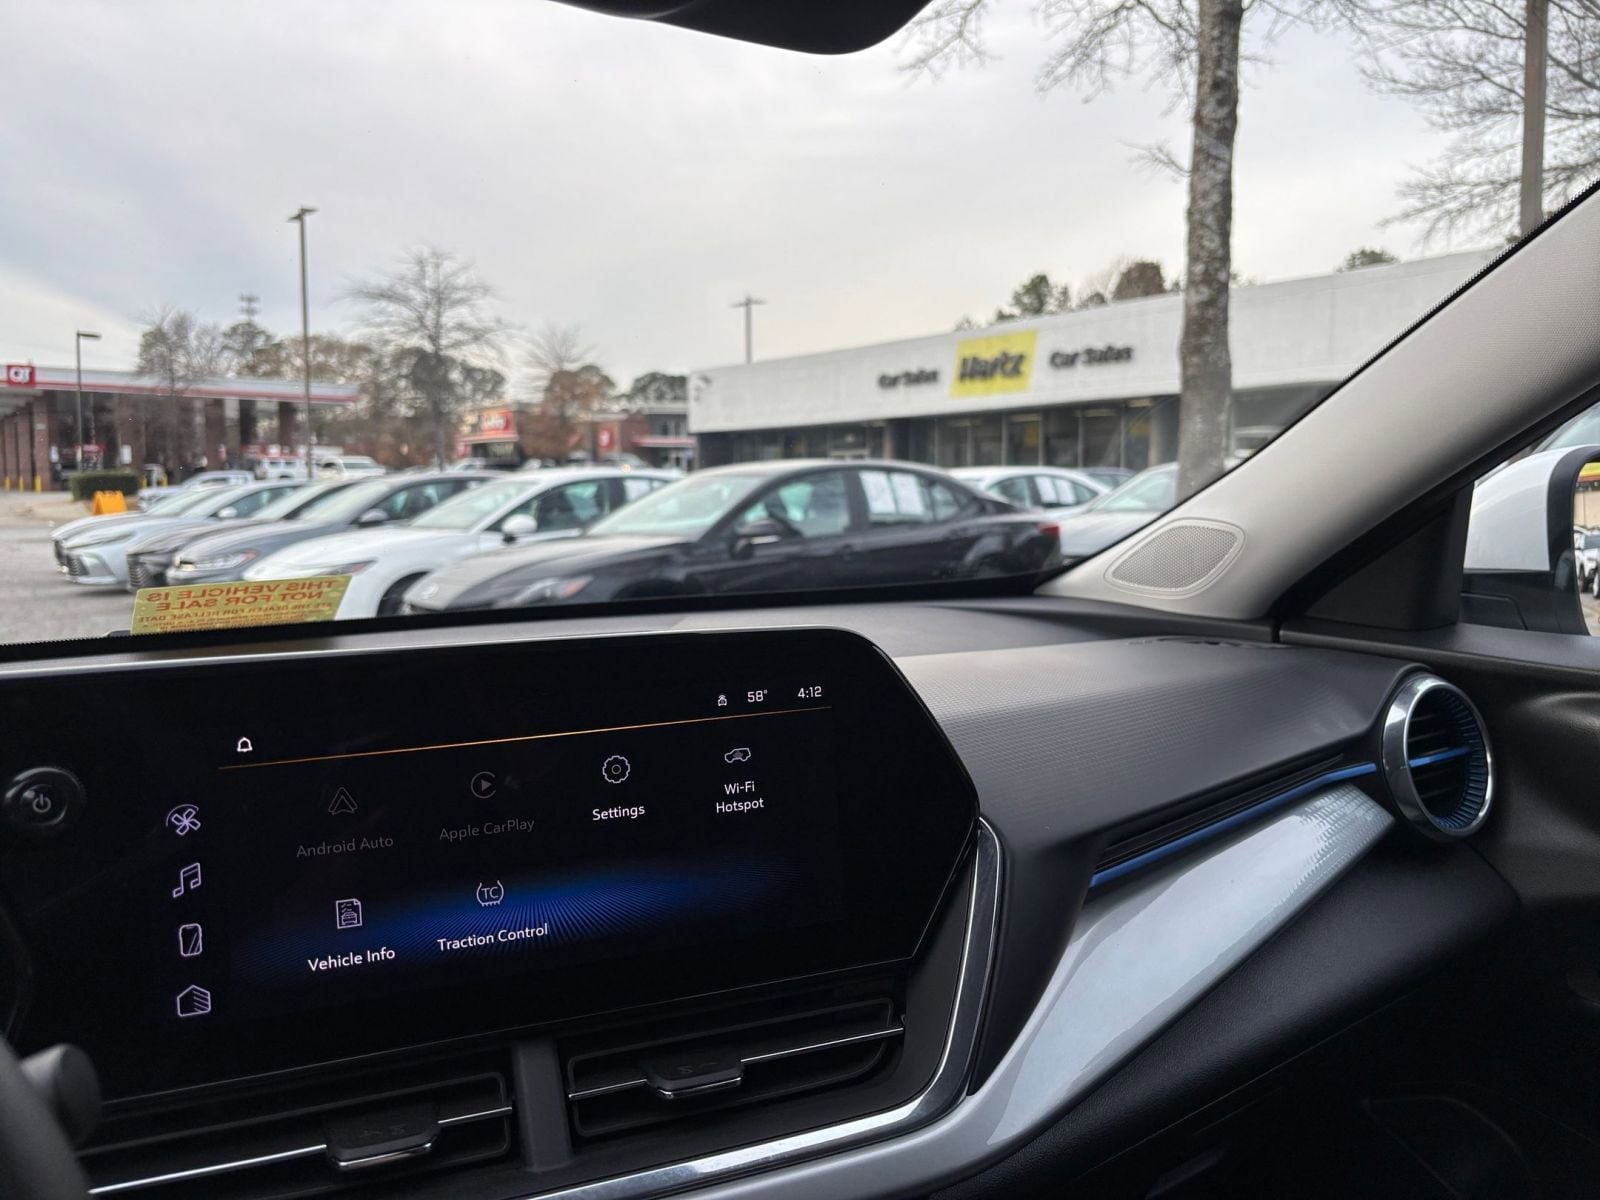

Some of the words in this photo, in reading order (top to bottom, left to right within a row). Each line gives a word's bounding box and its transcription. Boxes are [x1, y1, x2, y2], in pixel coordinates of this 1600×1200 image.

[958, 352, 1026, 382] Hertz
[1049, 350, 1079, 369] Car
[1082, 346, 1134, 365] Sales
[797, 685, 822, 699] 4:12
[724, 781, 755, 795] Wi-Fi
[592, 805, 646, 821] Settings
[716, 797, 765, 814] Hotspot
[439, 824, 480, 842] Apple
[483, 818, 535, 835] CarPlay
[296, 839, 356, 858] Android
[360, 836, 394, 850] Auto
[481, 886, 499, 900] TC
[437, 933, 495, 951] Traction
[498, 923, 549, 942] Control
[307, 951, 363, 972] Vehicle
[366, 946, 396, 963] Info
